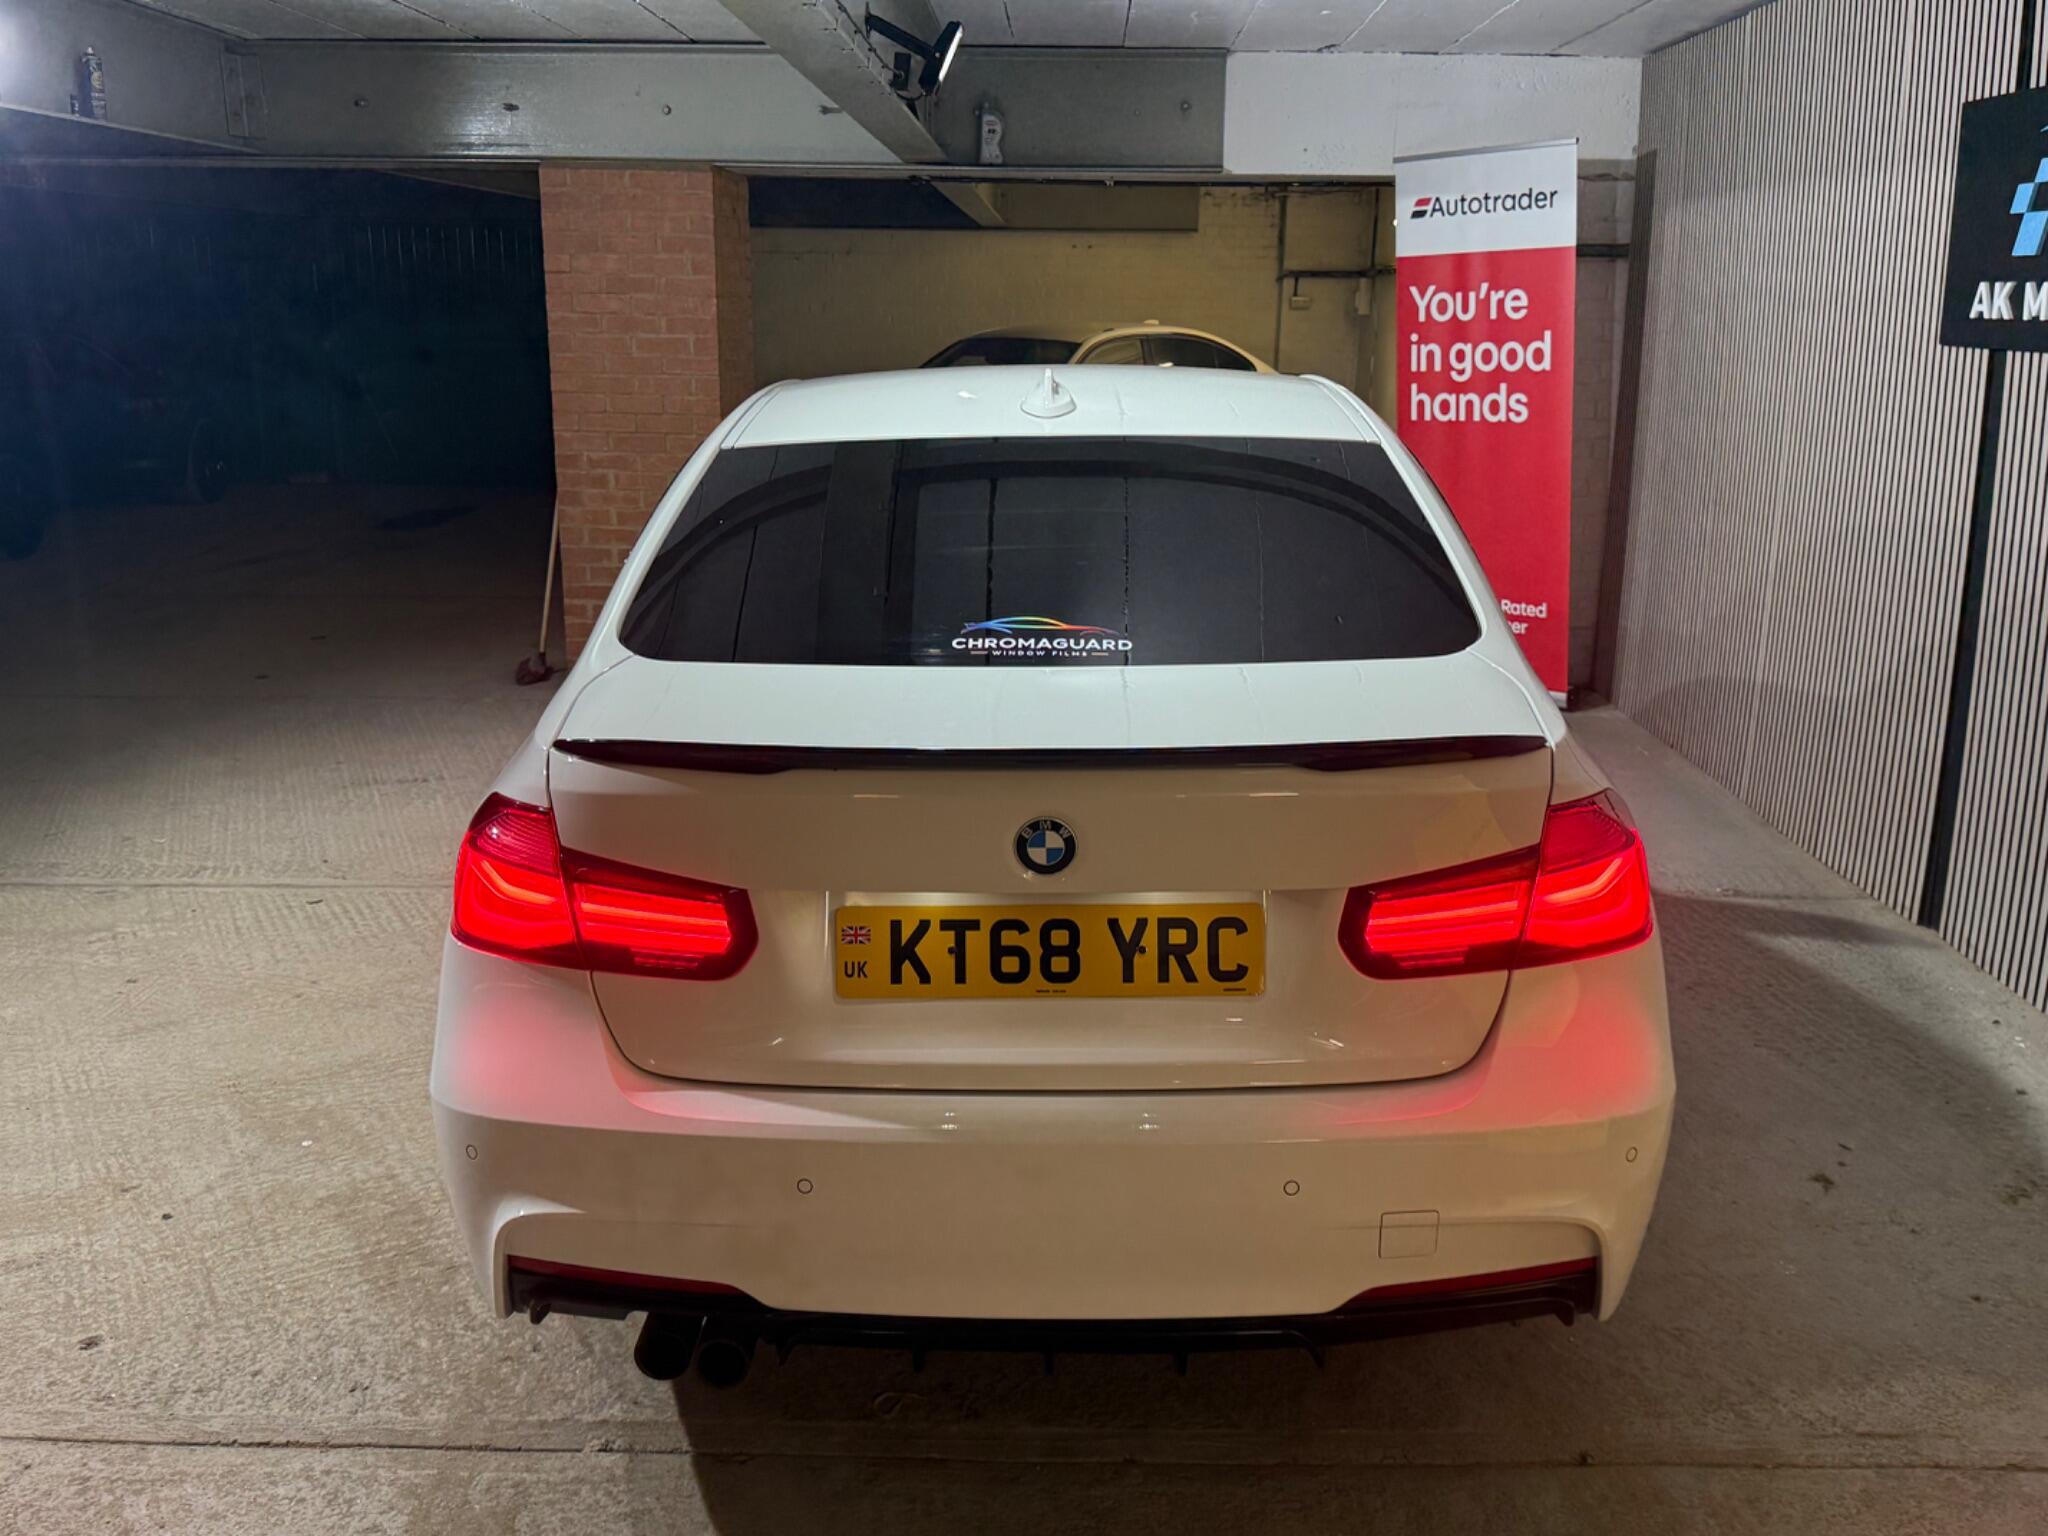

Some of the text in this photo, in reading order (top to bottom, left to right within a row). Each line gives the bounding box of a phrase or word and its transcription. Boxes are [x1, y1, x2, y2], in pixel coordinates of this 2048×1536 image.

[1430, 187, 1558, 217] Autotrader
[1409, 282, 1529, 322] You're
[1969, 281, 2017, 320] AK
[1410, 330, 1551, 382] in good
[1410, 383, 1528, 423] hands
[1501, 599, 1547, 618] Rated
[951, 638, 1133, 650] CHROMAGUARD
[844, 960, 868, 979] UK
[890, 916, 1249, 985] KT68 YRC
